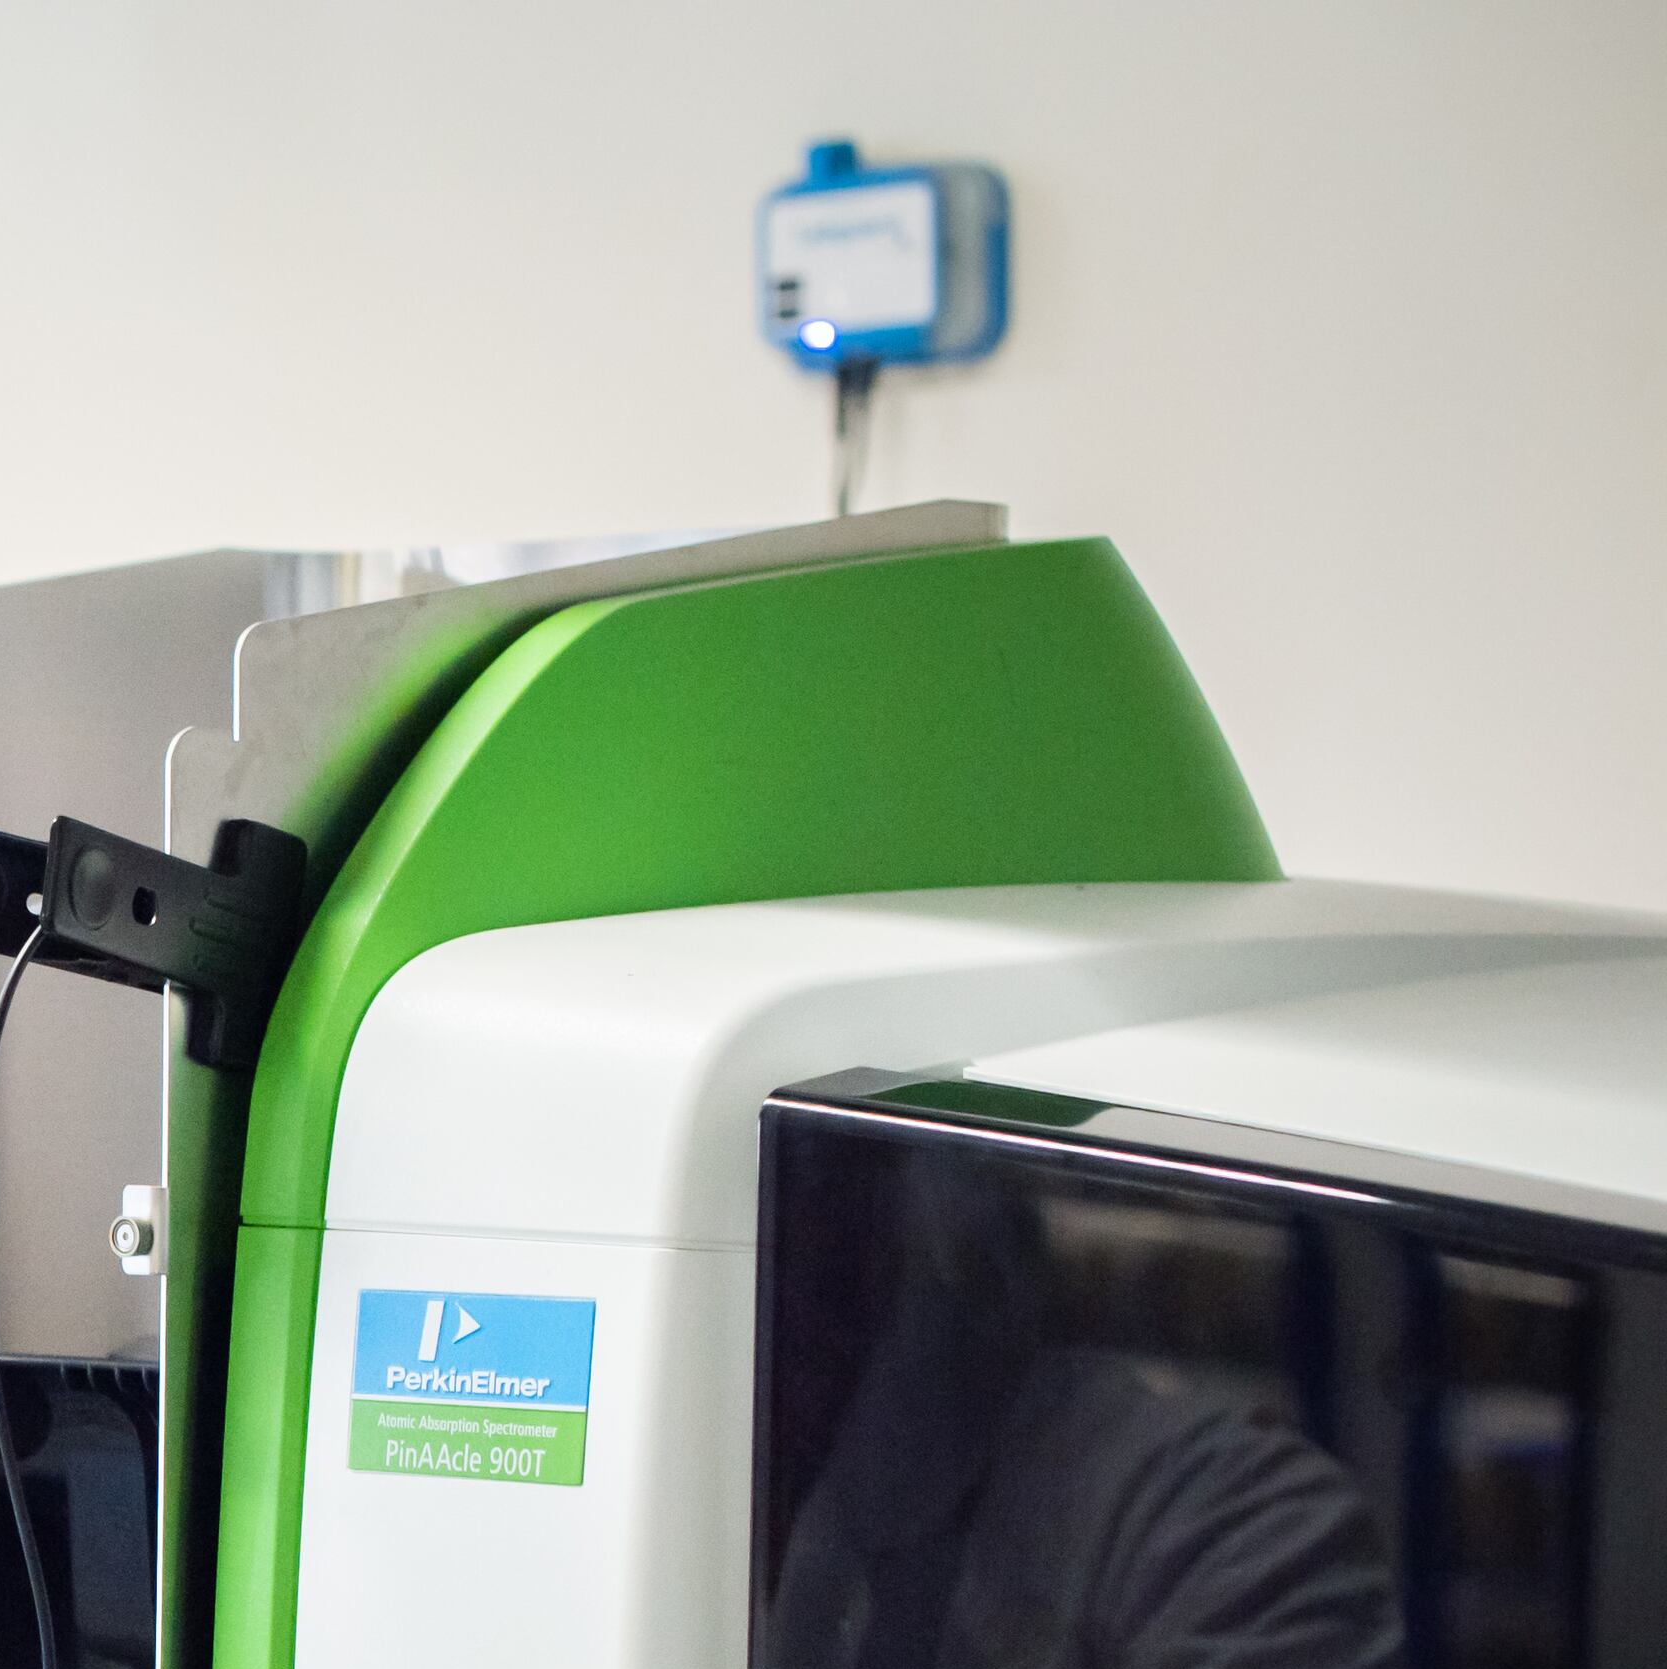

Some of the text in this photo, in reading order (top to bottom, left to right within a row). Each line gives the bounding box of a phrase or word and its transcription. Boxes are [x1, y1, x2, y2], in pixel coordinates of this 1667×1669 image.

[386, 1366, 550, 1398] PerkinElmer
[377, 1412, 557, 1439] Atomic Absorption Spectrometer
[385, 1439, 546, 1478] PinAAcle 900T
